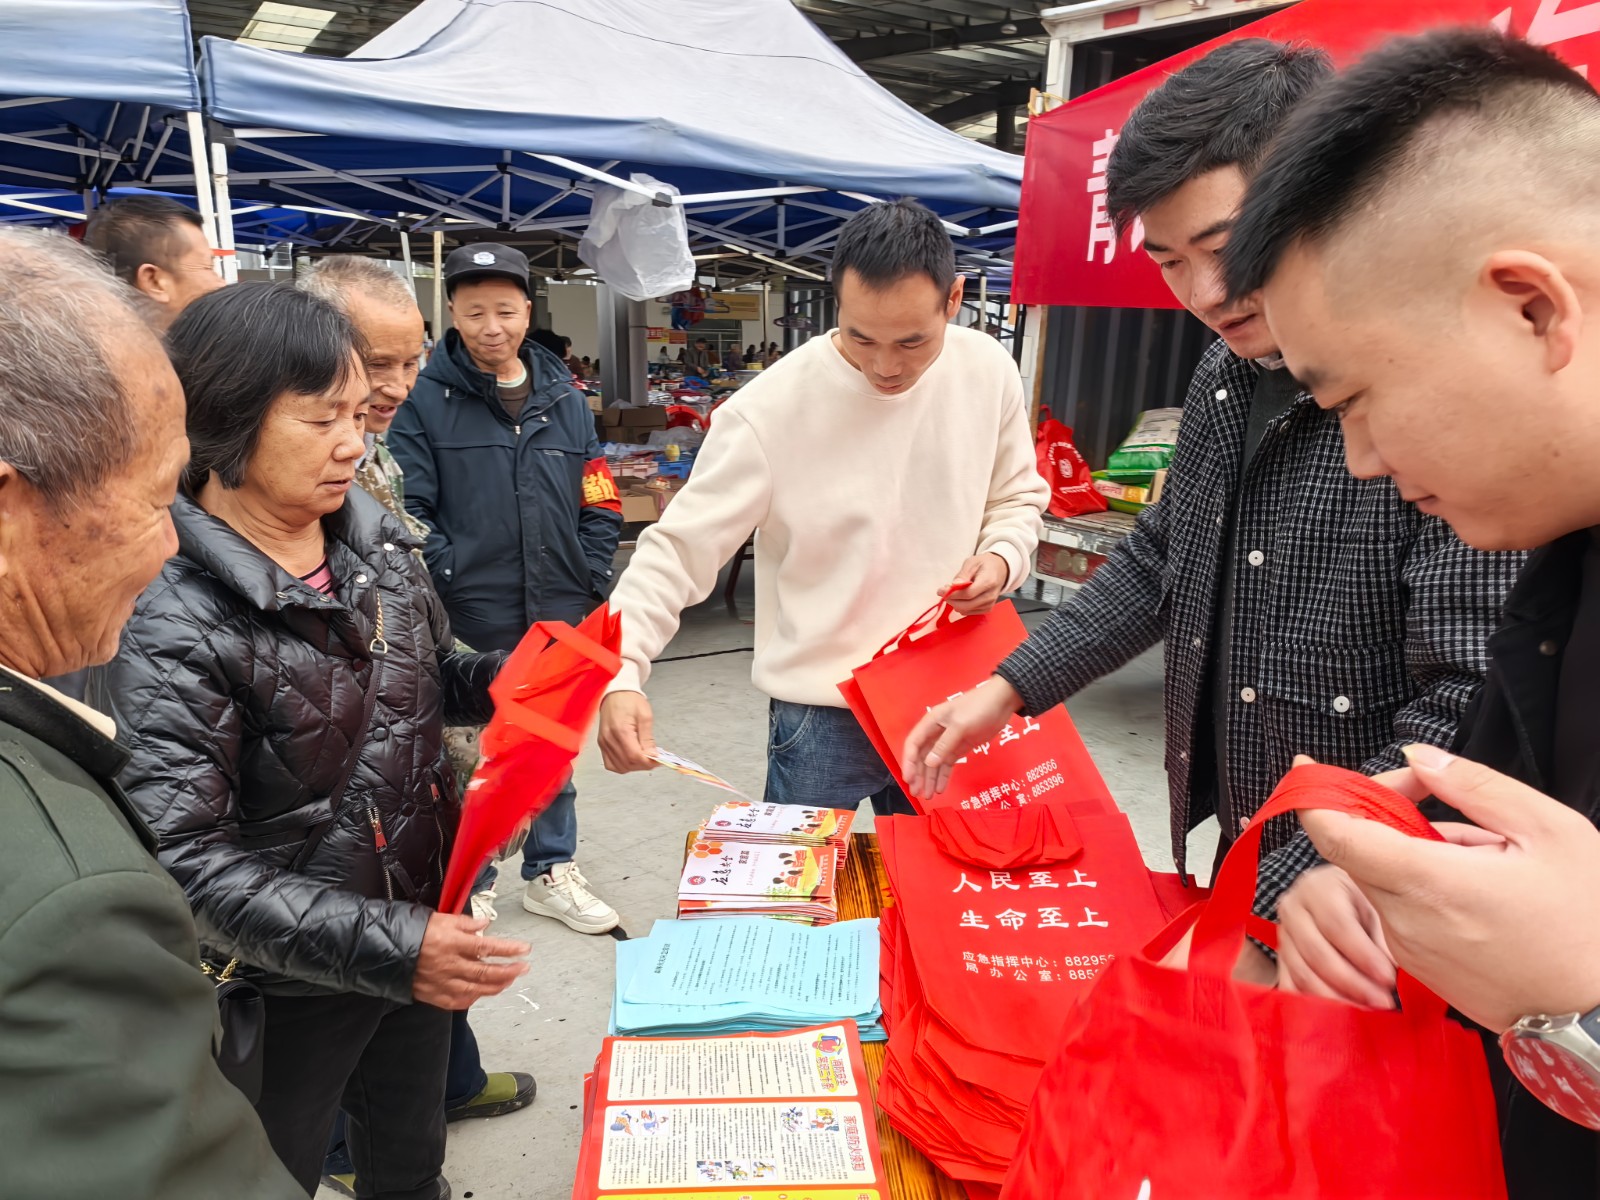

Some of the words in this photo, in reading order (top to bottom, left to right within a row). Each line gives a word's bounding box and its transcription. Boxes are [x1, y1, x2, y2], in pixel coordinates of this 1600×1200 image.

[582, 471, 618, 504] 勤
[952, 869, 1098, 894] 人民至上
[959, 906, 1109, 931] 生命至上
[965, 961, 1100, 982] 局办公室：885
